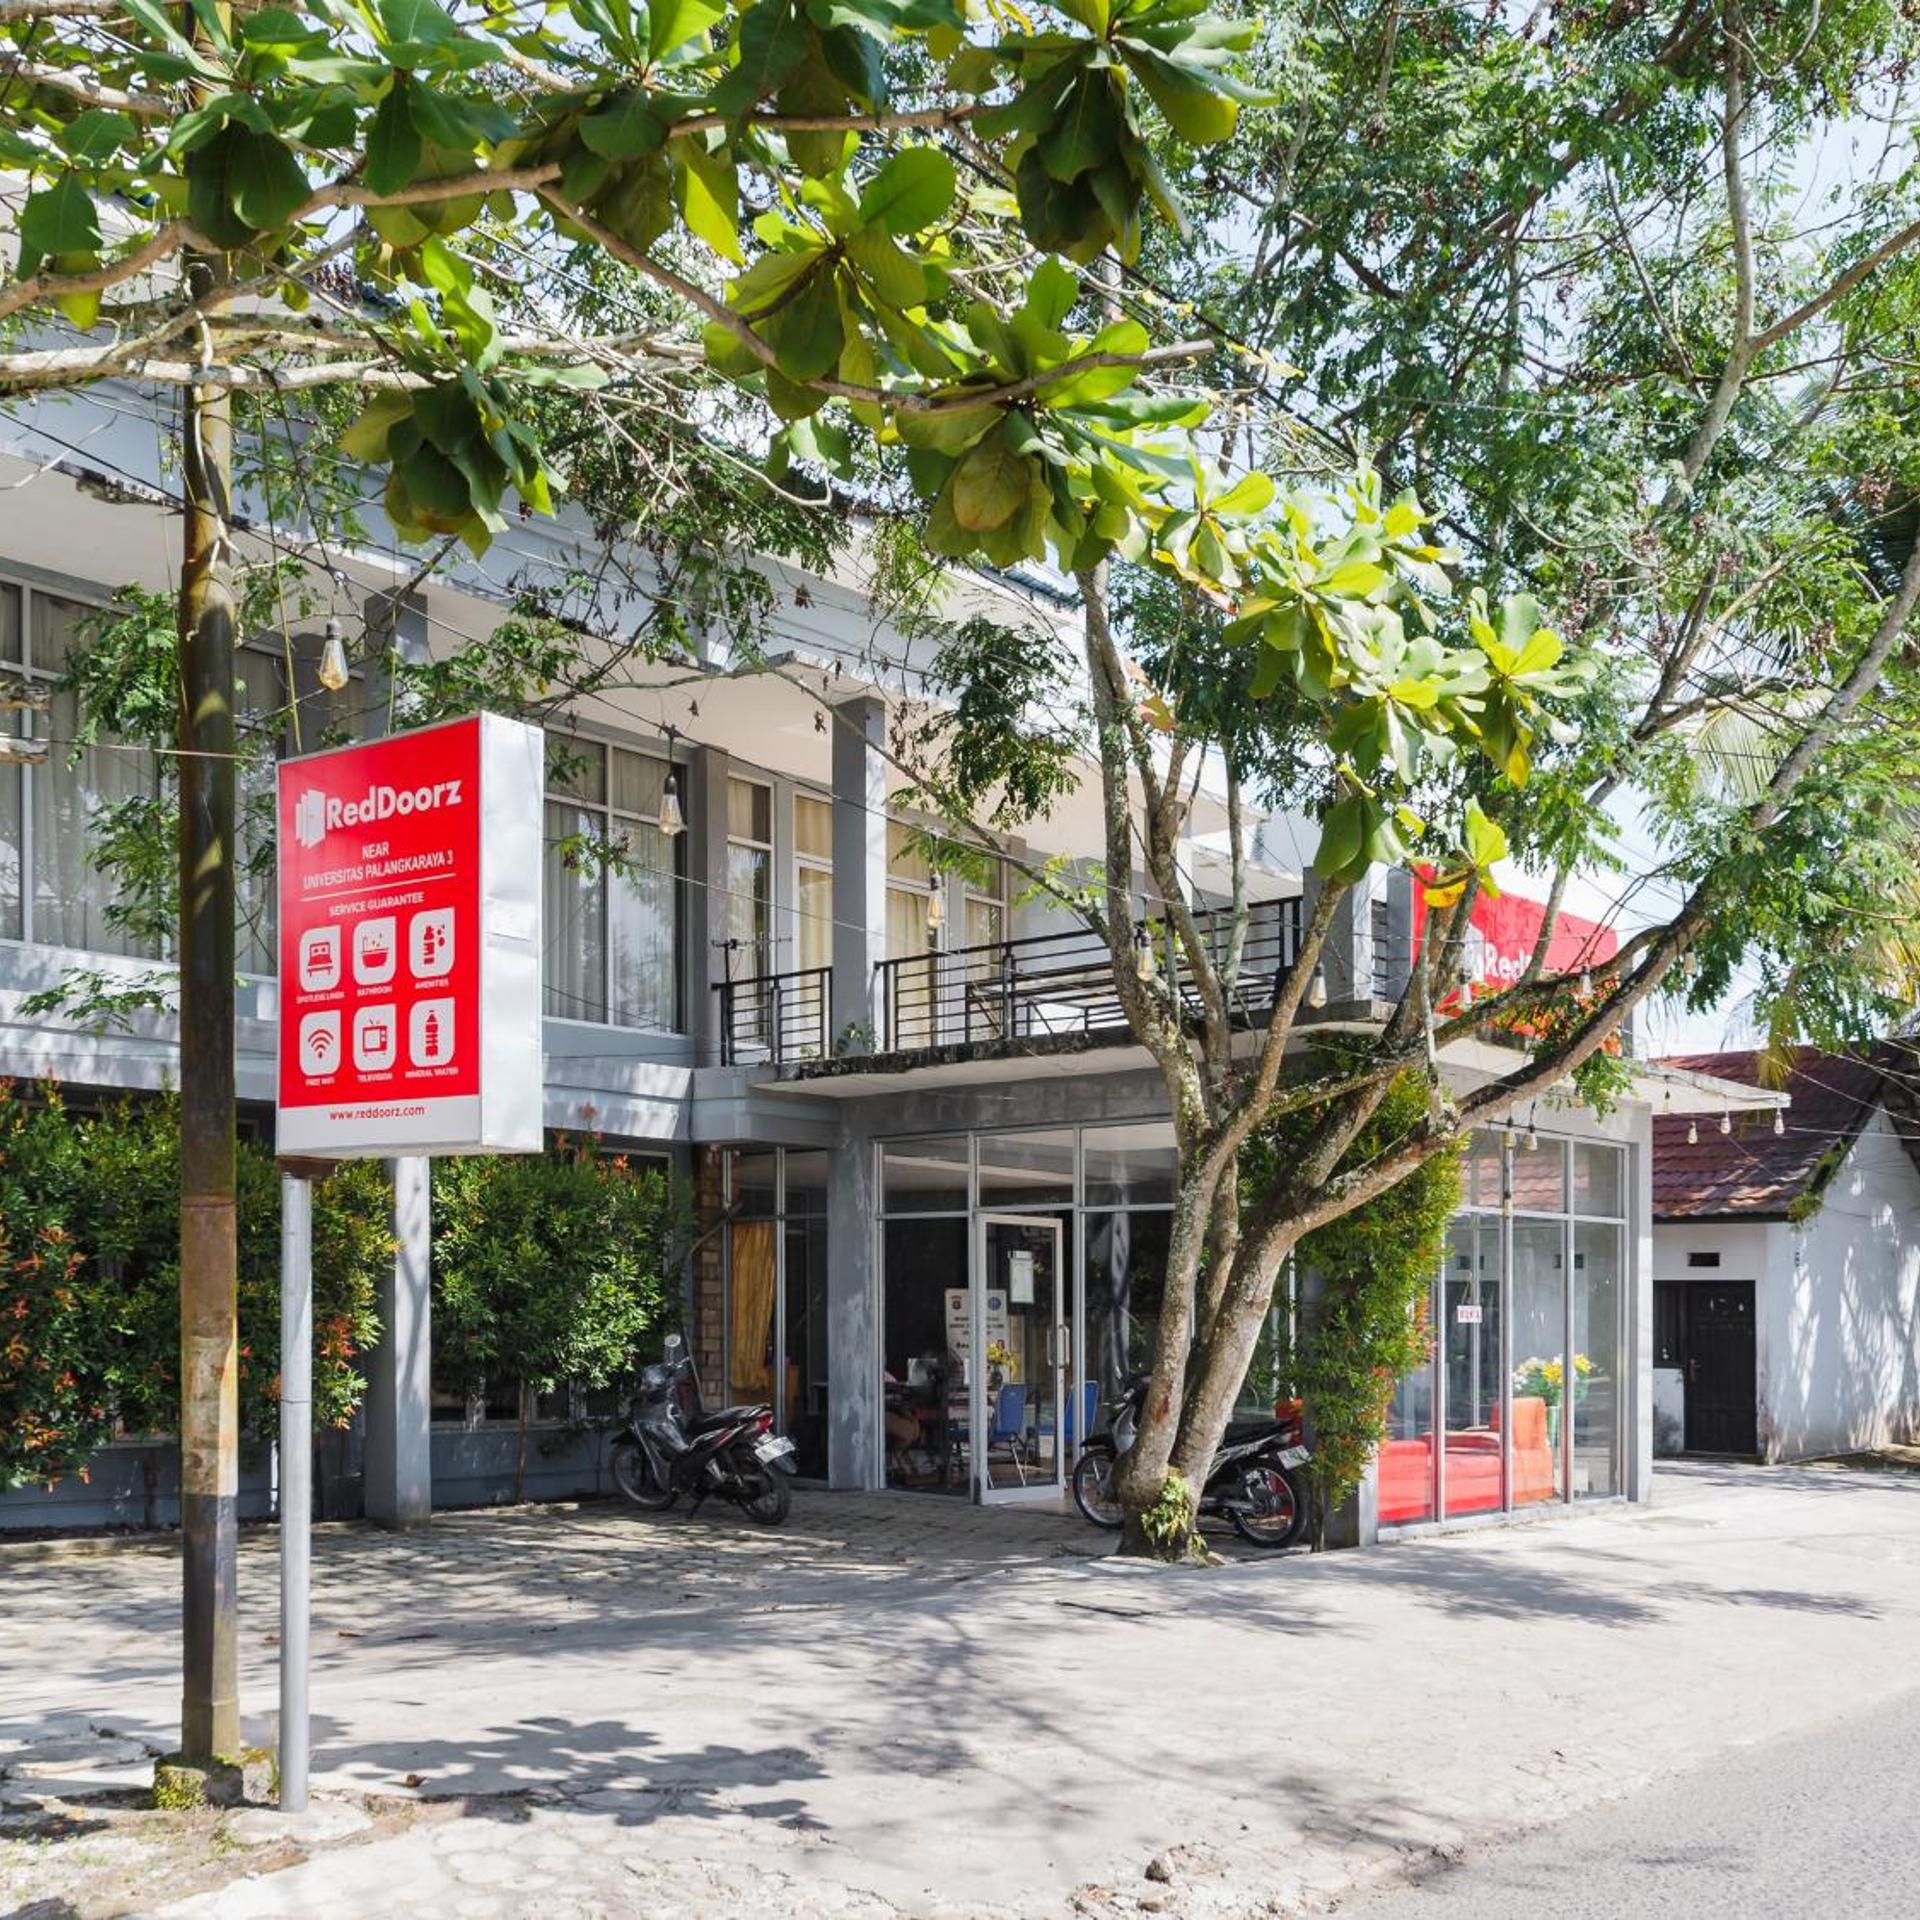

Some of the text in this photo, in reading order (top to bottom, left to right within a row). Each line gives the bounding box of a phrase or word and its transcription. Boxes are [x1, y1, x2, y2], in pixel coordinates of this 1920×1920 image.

[326, 780, 462, 830] RedDoorz
[362, 841, 389, 860] NEAR
[303, 850, 453, 889] UNIVERSITAS PALANGKARAYA 3
[329, 892, 424, 917] SERVICE GUARANTEE
[329, 1105, 425, 1121] www.reddoorz.com
